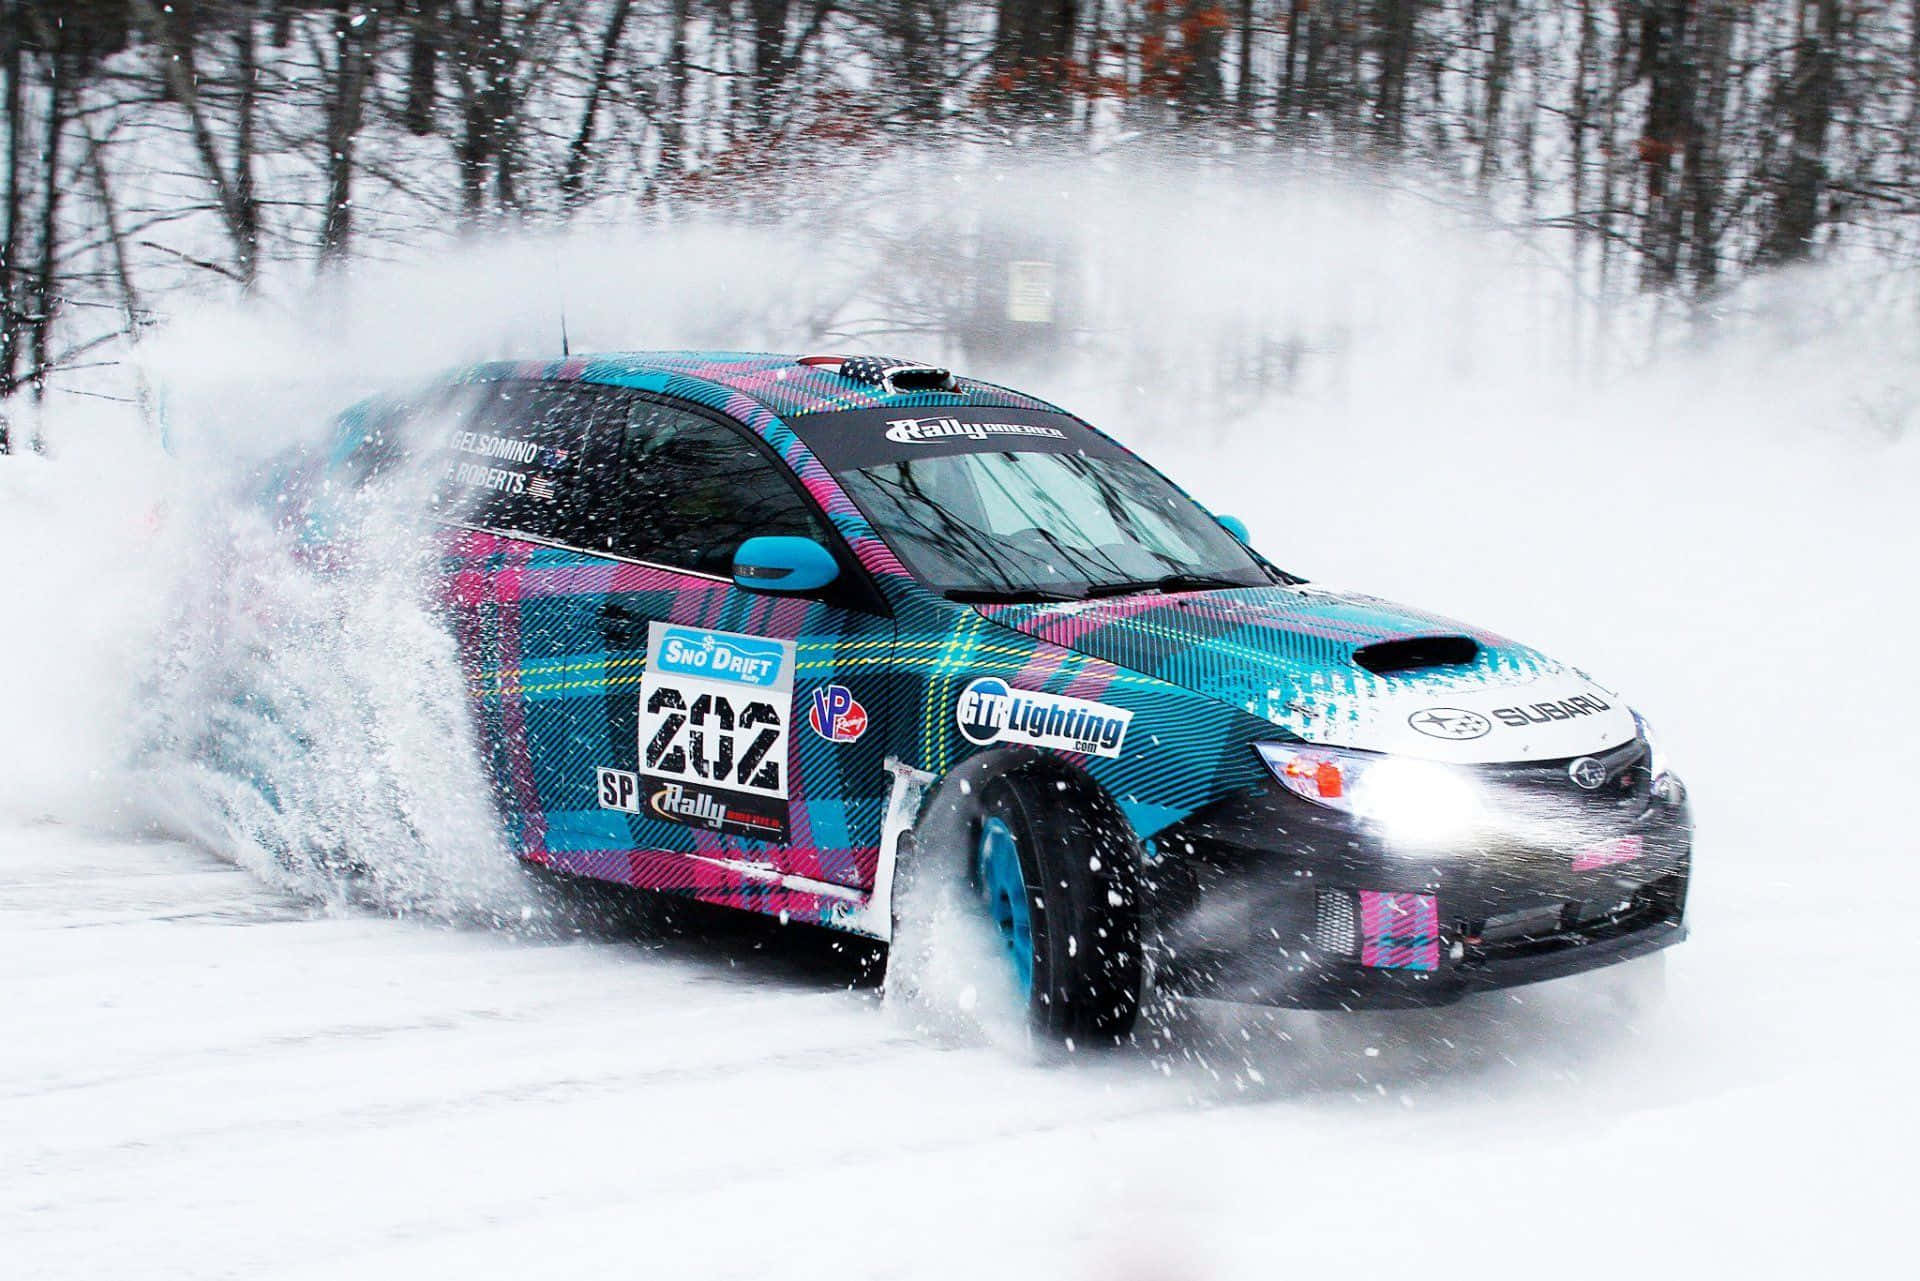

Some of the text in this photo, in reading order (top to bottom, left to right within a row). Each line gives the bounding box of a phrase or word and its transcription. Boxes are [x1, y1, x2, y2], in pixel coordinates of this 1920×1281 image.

[452, 431, 538, 464] GELSOMINO
[885, 416, 988, 443] Rally
[812, 684, 852, 740] VP
[1492, 692, 1611, 727] SUBARU
[646, 687, 781, 790] 202
[602, 772, 633, 808] SP
[662, 782, 727, 828] Rally
